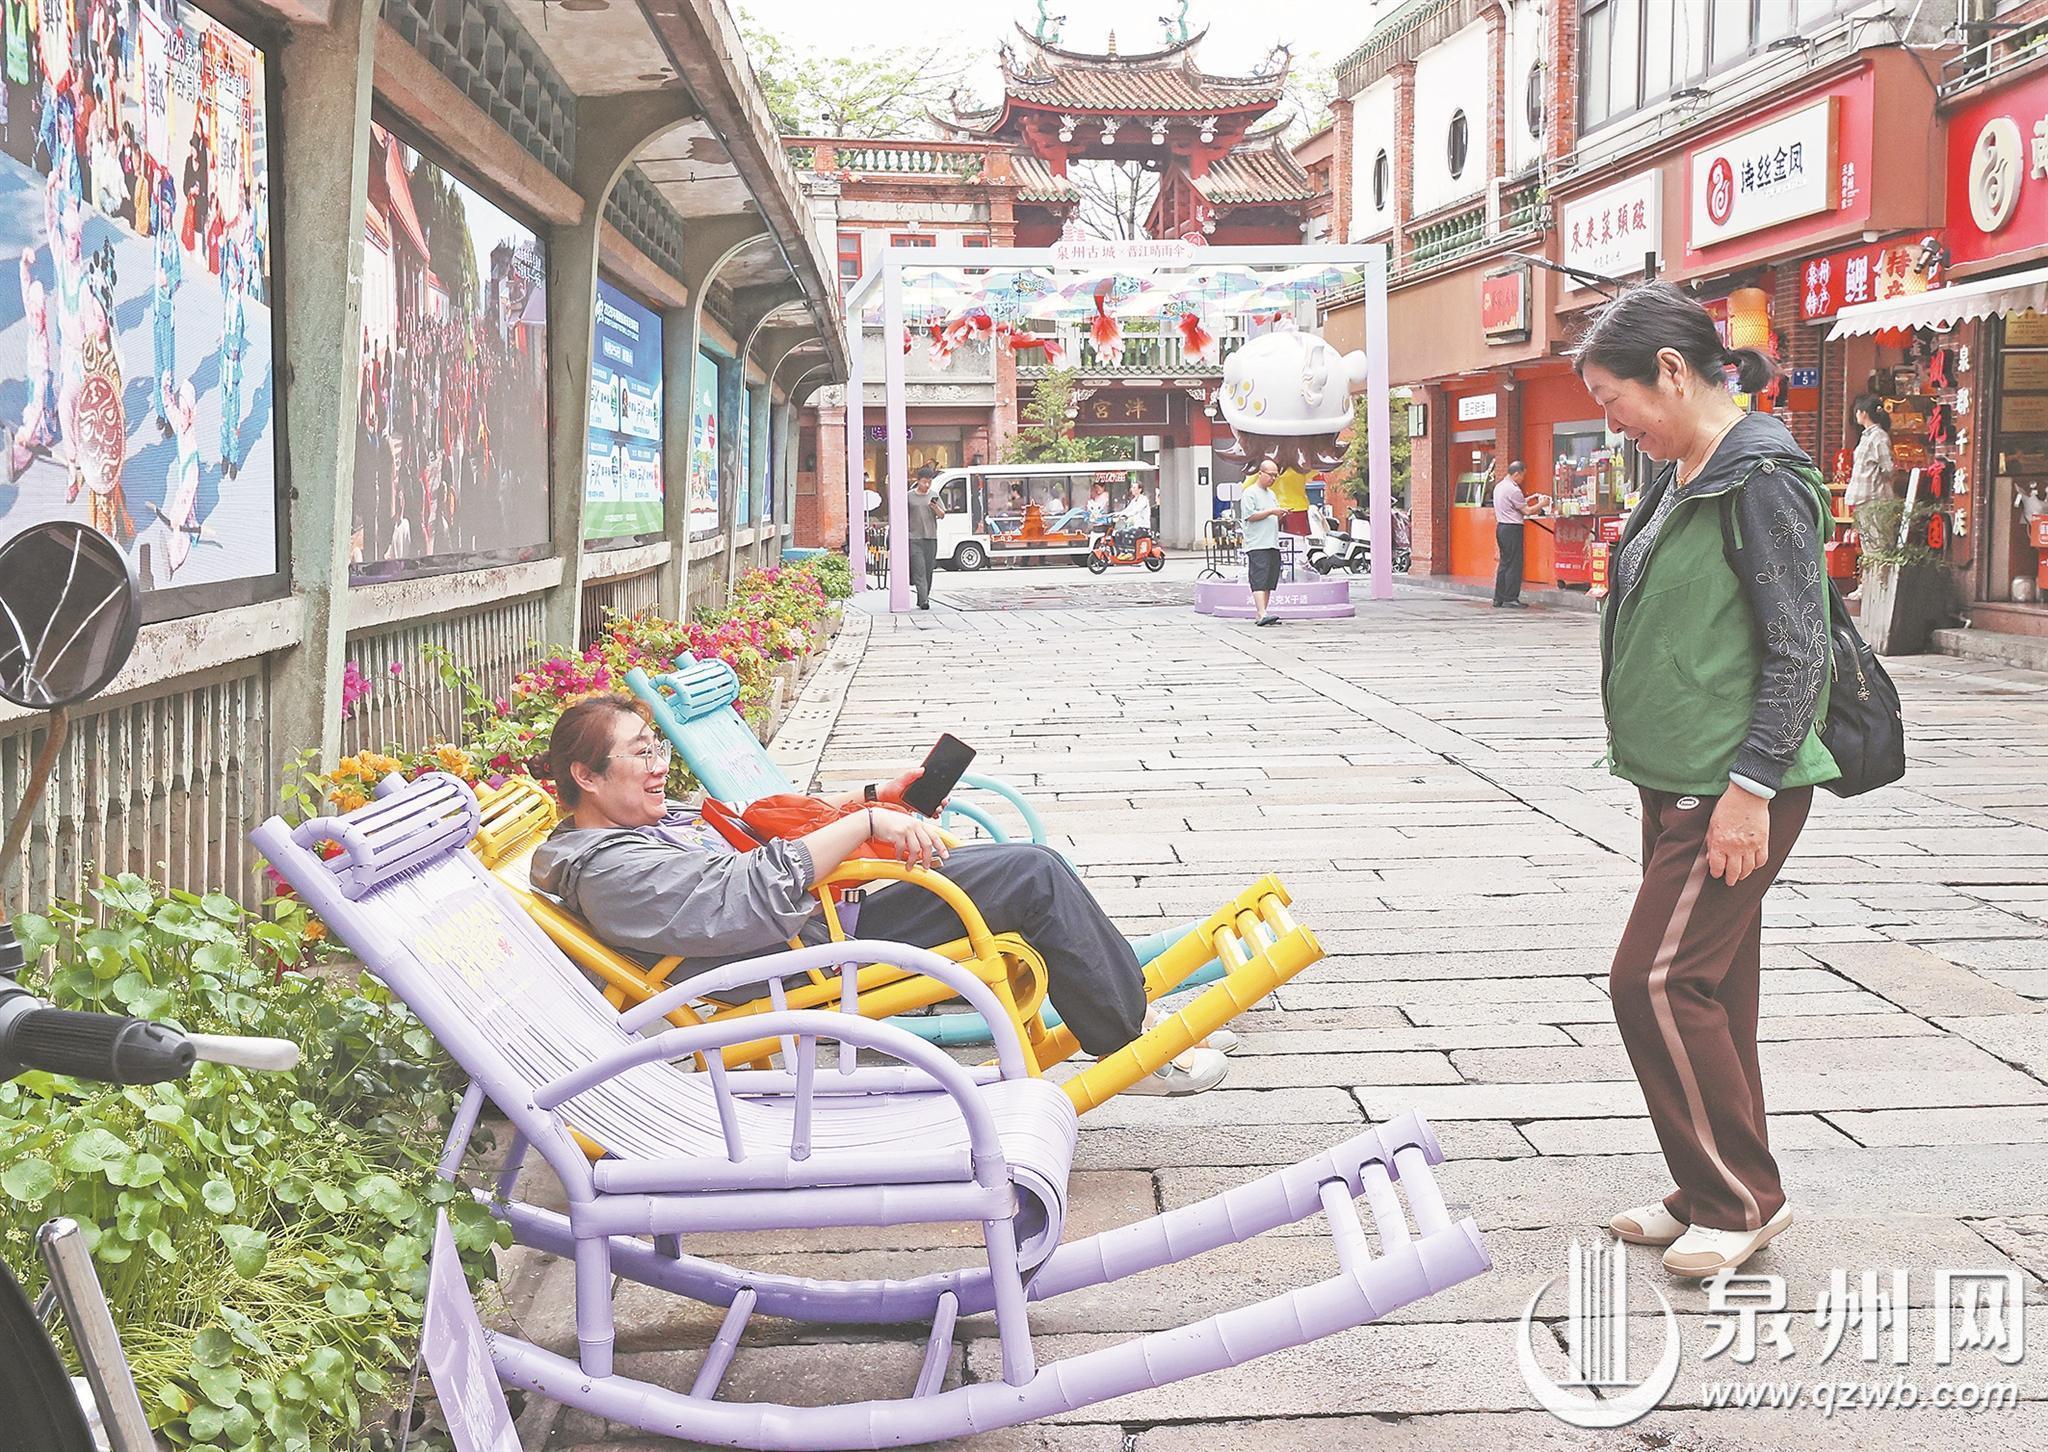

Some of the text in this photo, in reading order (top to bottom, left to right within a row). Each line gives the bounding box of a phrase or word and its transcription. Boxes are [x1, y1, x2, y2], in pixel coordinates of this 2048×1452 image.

[1056, 246, 1116, 260] 泉州古城
[1802, 377, 1809, 385] 5
[1246, 594, 1308, 605] 鸿尔克X于适
